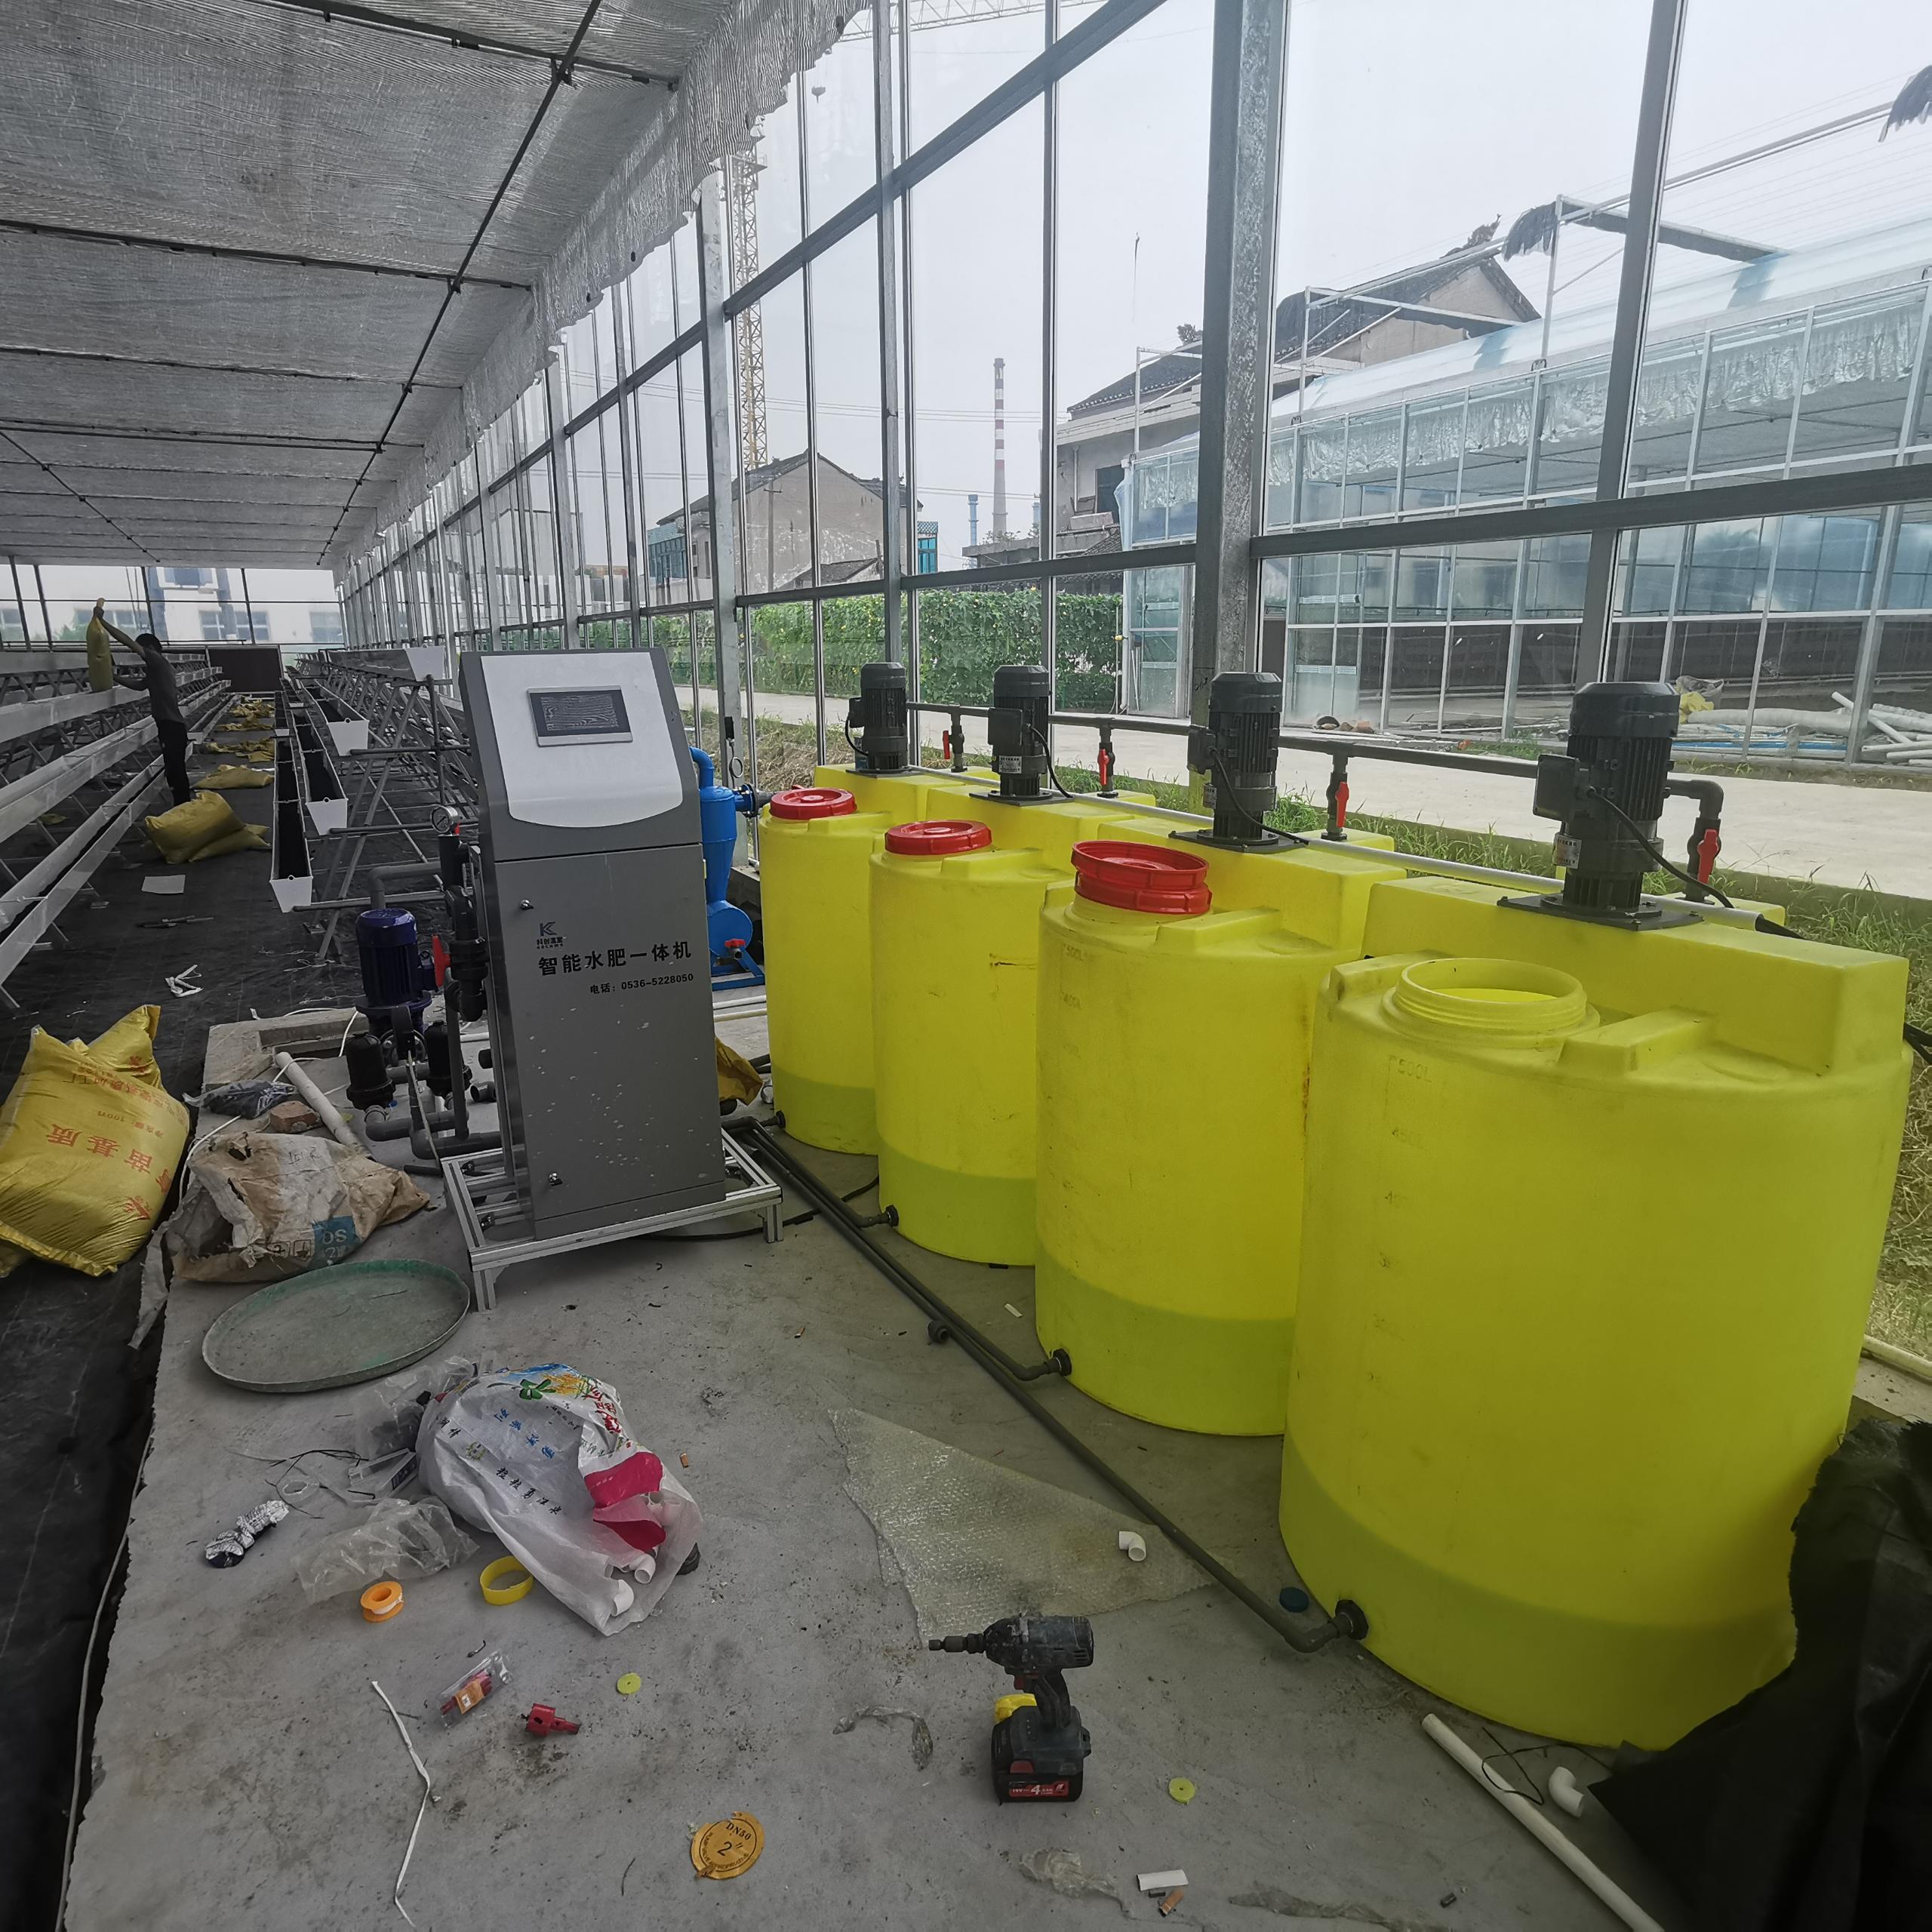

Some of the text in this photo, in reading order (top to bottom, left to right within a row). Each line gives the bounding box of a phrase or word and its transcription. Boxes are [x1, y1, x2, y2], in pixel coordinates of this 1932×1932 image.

[538, 941, 691, 976] 智能水肥一体机
[1398, 1058, 1432, 1082] 500L
[725, 1822, 752, 1841] DN50
